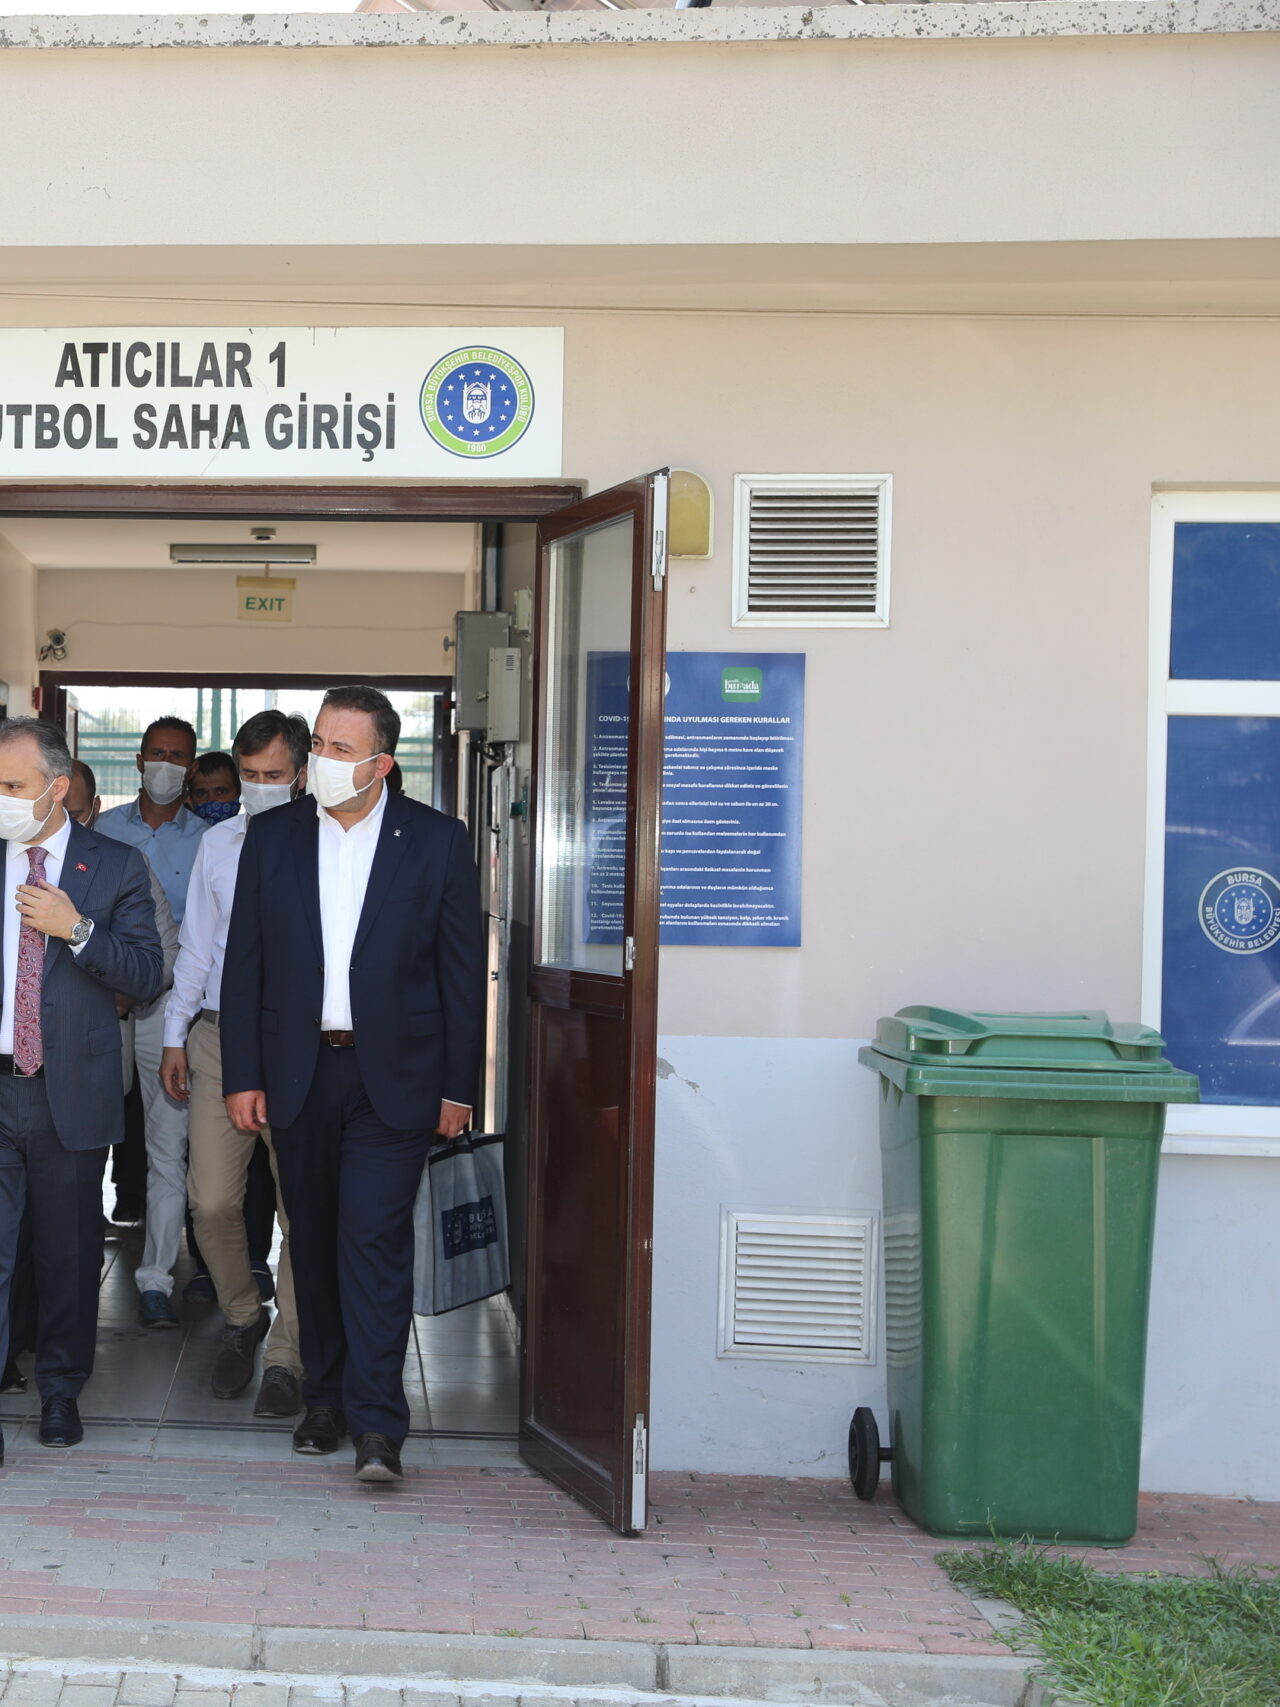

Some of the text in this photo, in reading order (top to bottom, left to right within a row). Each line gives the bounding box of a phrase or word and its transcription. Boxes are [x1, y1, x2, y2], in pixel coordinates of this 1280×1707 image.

[55, 342, 286, 388] ATICILAR 1
[426, 392, 436, 422] BURSA
[132, 404, 250, 450] SAHA
[265, 392, 395, 462] GİRİŞİ
[246, 596, 286, 612] EXIT
[1226, 872, 1263, 886] BURSA
[1206, 907, 1245, 948] BÜYÜKŞEHİR
